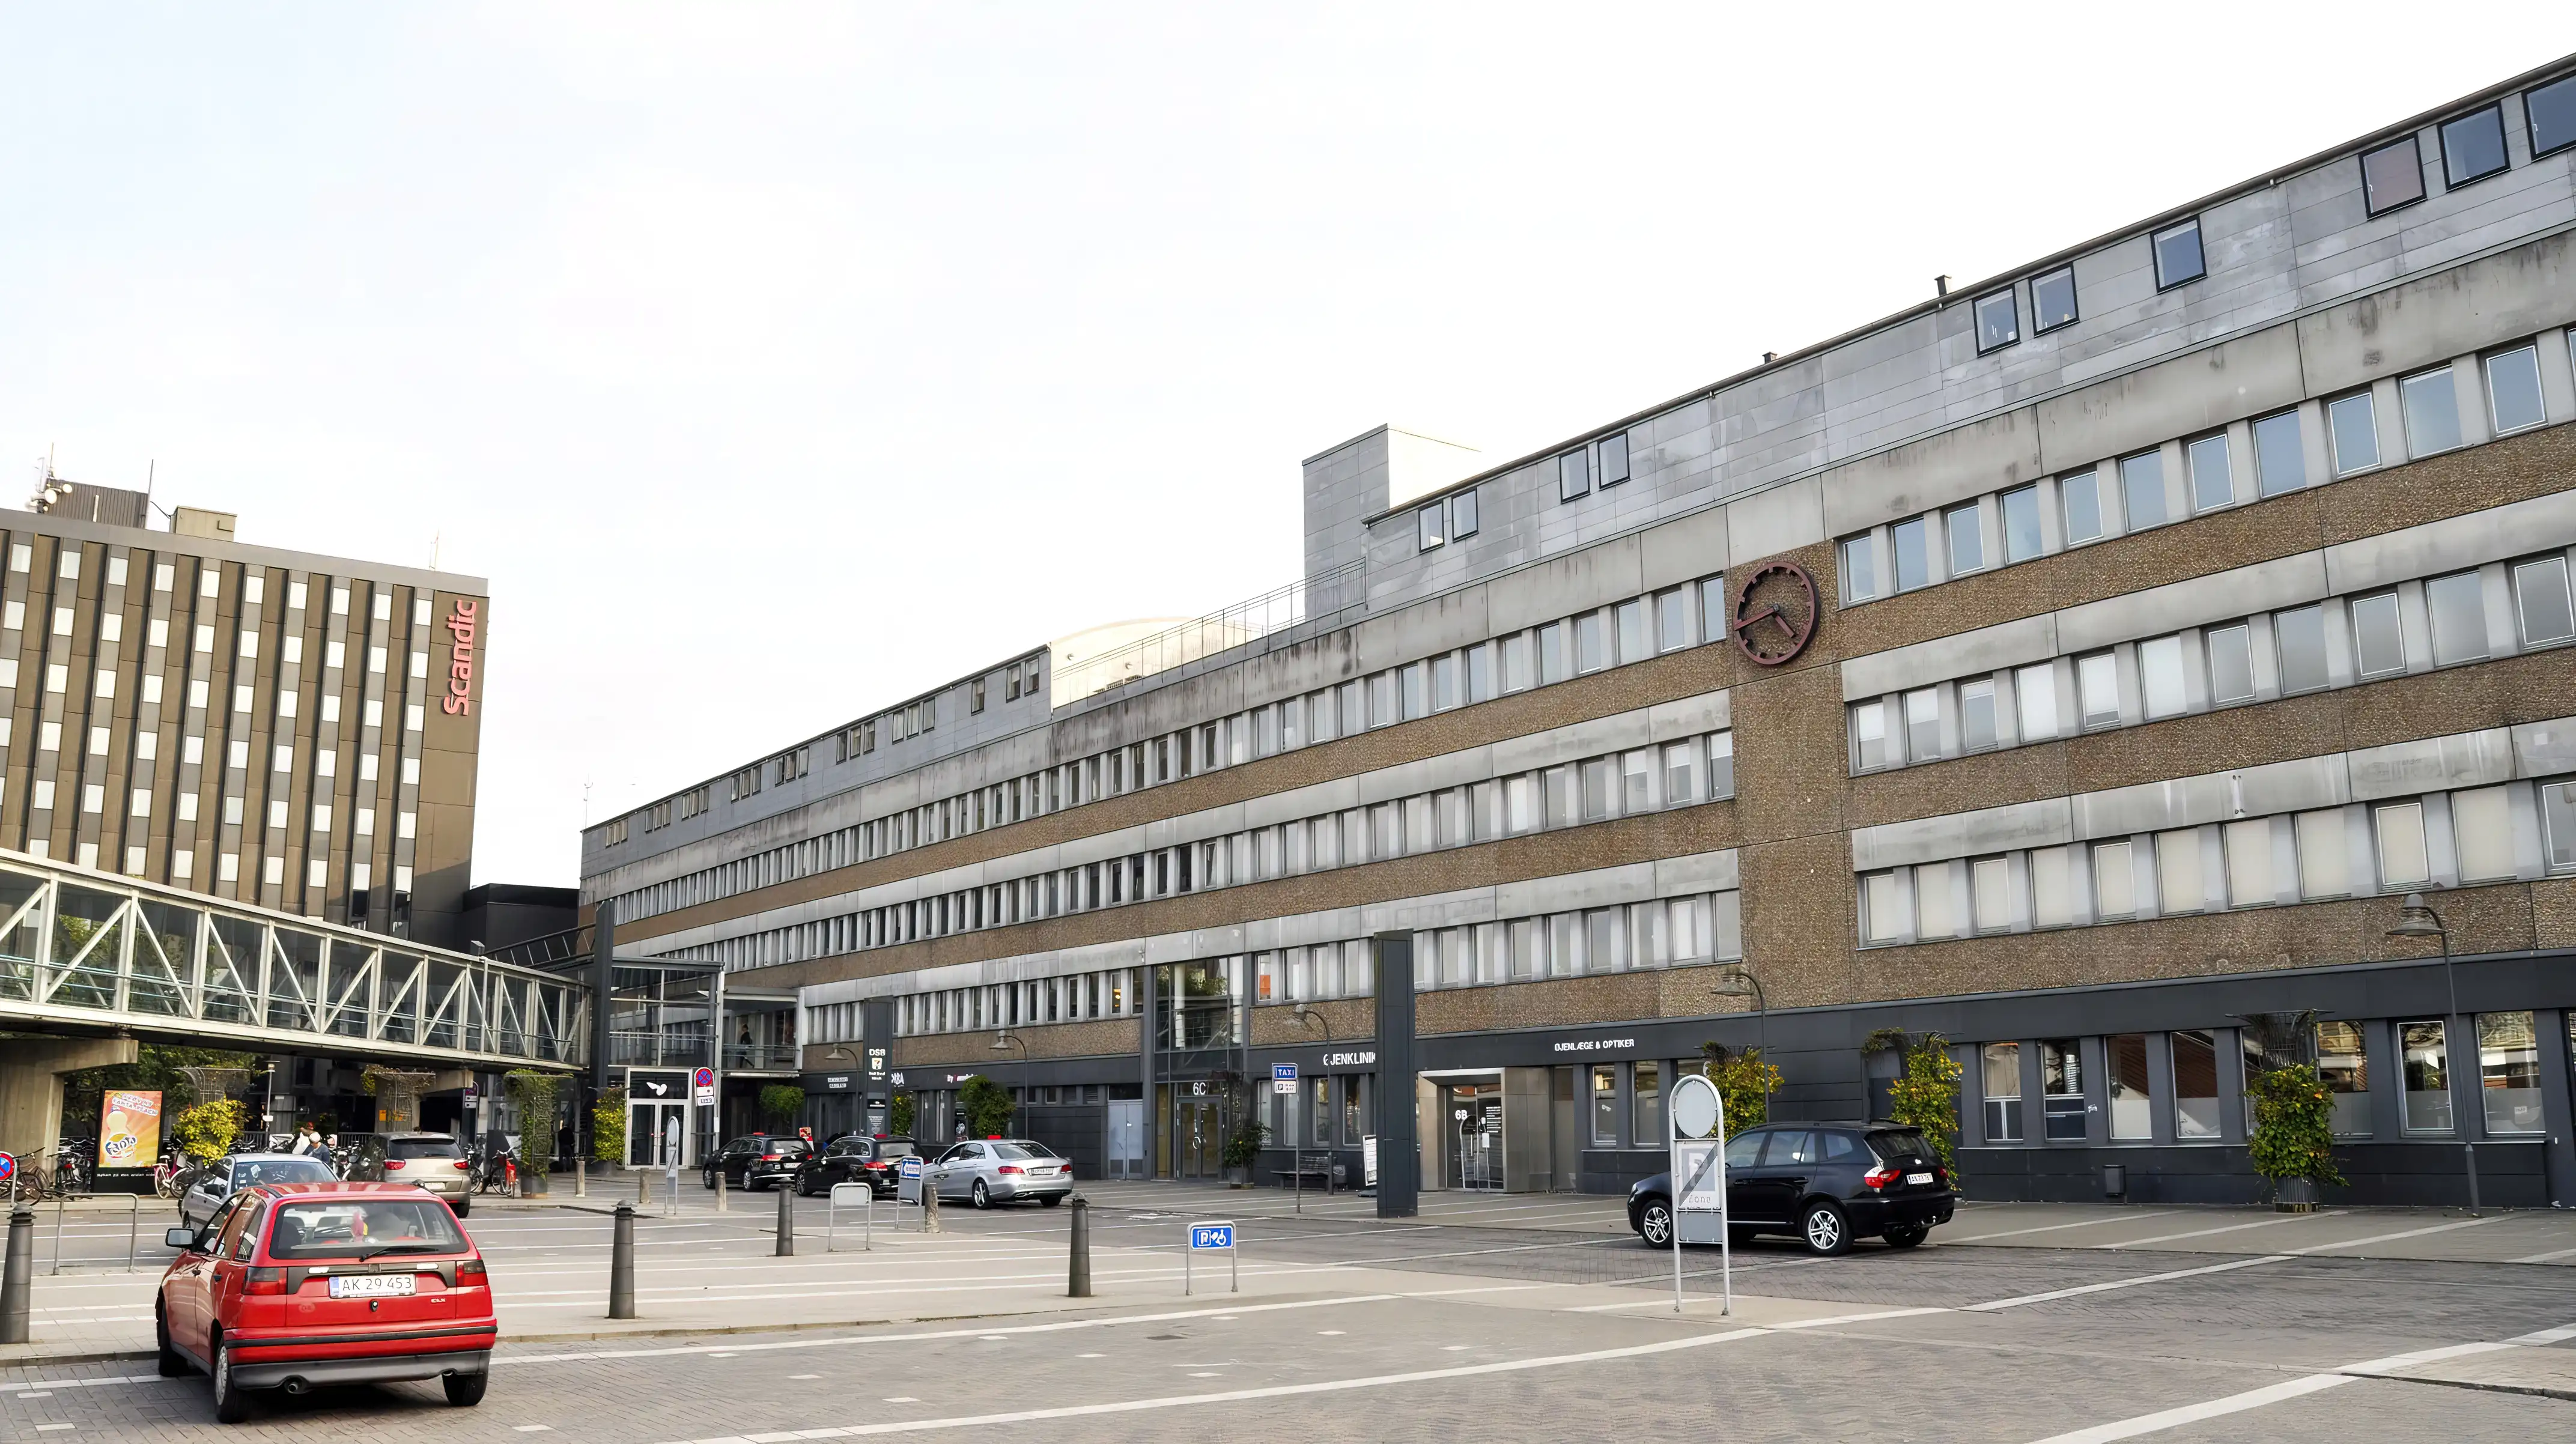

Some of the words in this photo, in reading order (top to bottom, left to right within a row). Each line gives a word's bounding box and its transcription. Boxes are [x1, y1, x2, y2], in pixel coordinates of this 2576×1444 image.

[443, 599, 477, 715] Scandic
[1603, 1039, 1635, 1049] OPTIKER
[1193, 1082, 1206, 1095] 6C
[1455, 1110, 1468, 1120] 6B
[342, 1279, 360, 1291] AK
[366, 1278, 381, 1290] 29
[387, 1277, 412, 1289] 453
